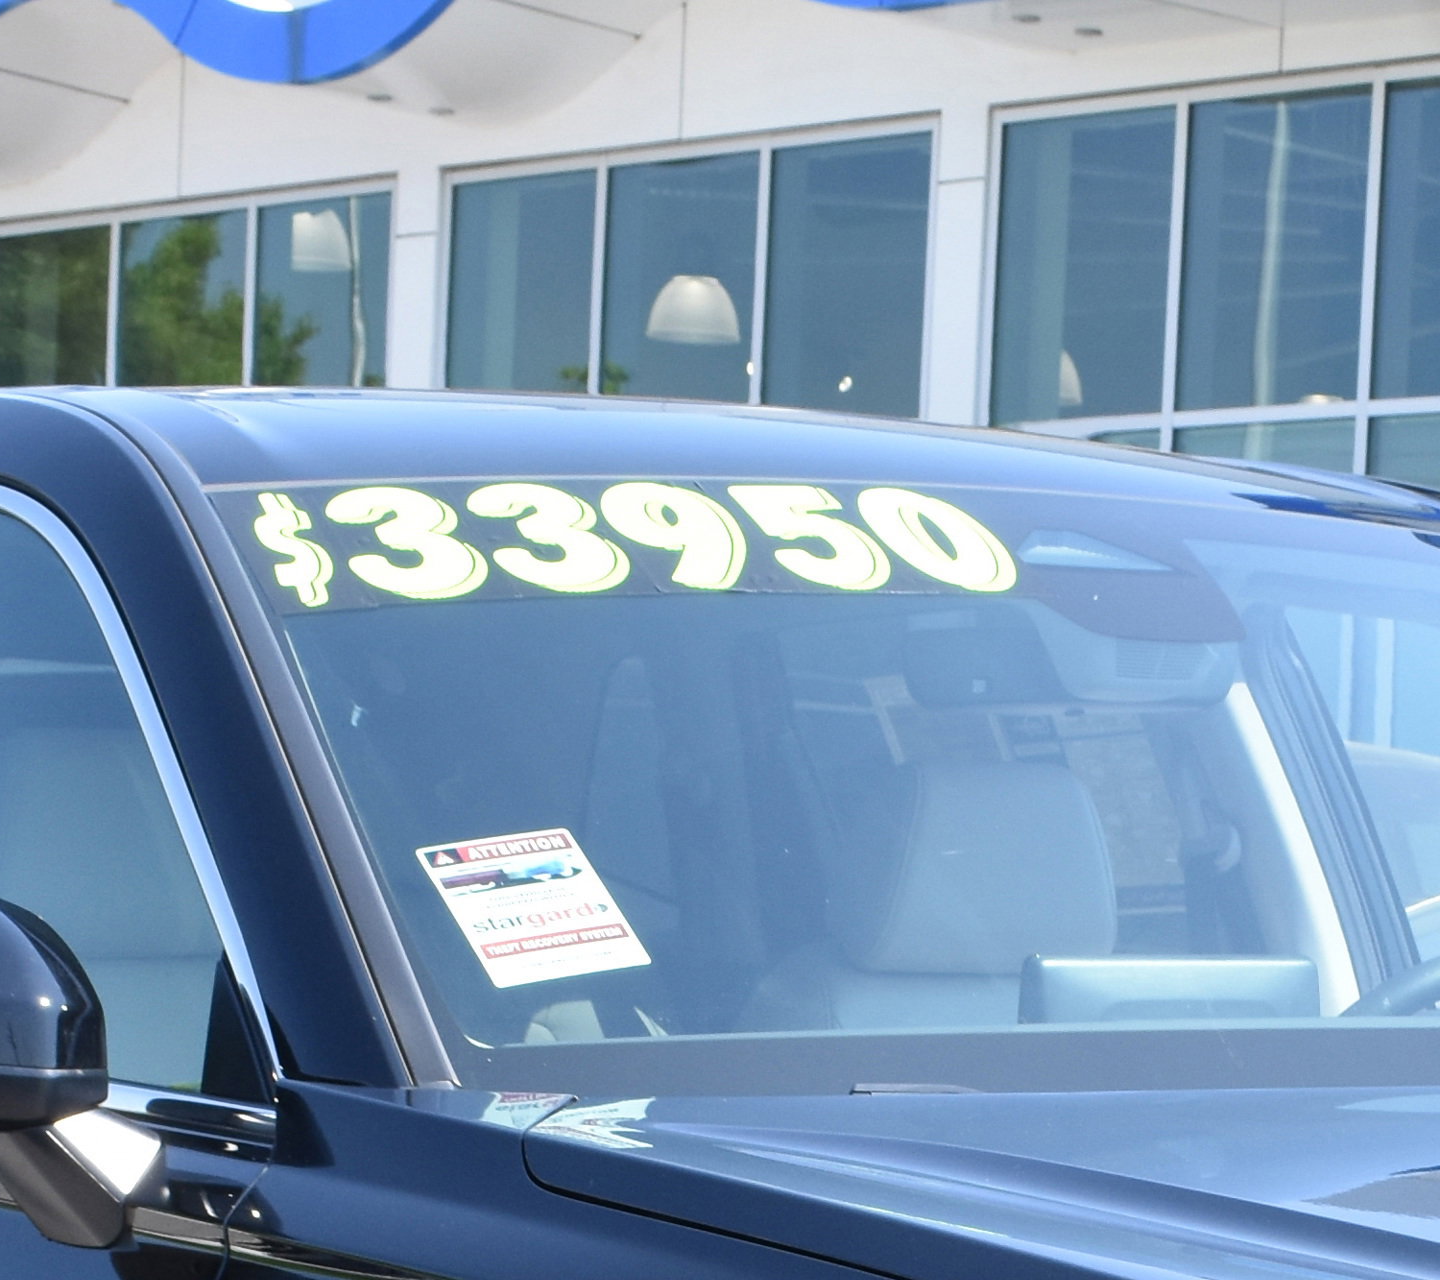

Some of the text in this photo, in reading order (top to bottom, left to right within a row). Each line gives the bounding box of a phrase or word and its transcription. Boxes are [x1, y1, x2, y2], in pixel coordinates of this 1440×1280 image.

[253, 482, 1018, 607] $33950
[466, 833, 566, 861] ATTENTION
[472, 903, 594, 934] stargard
[522, 933, 579, 951] RECOVERY
